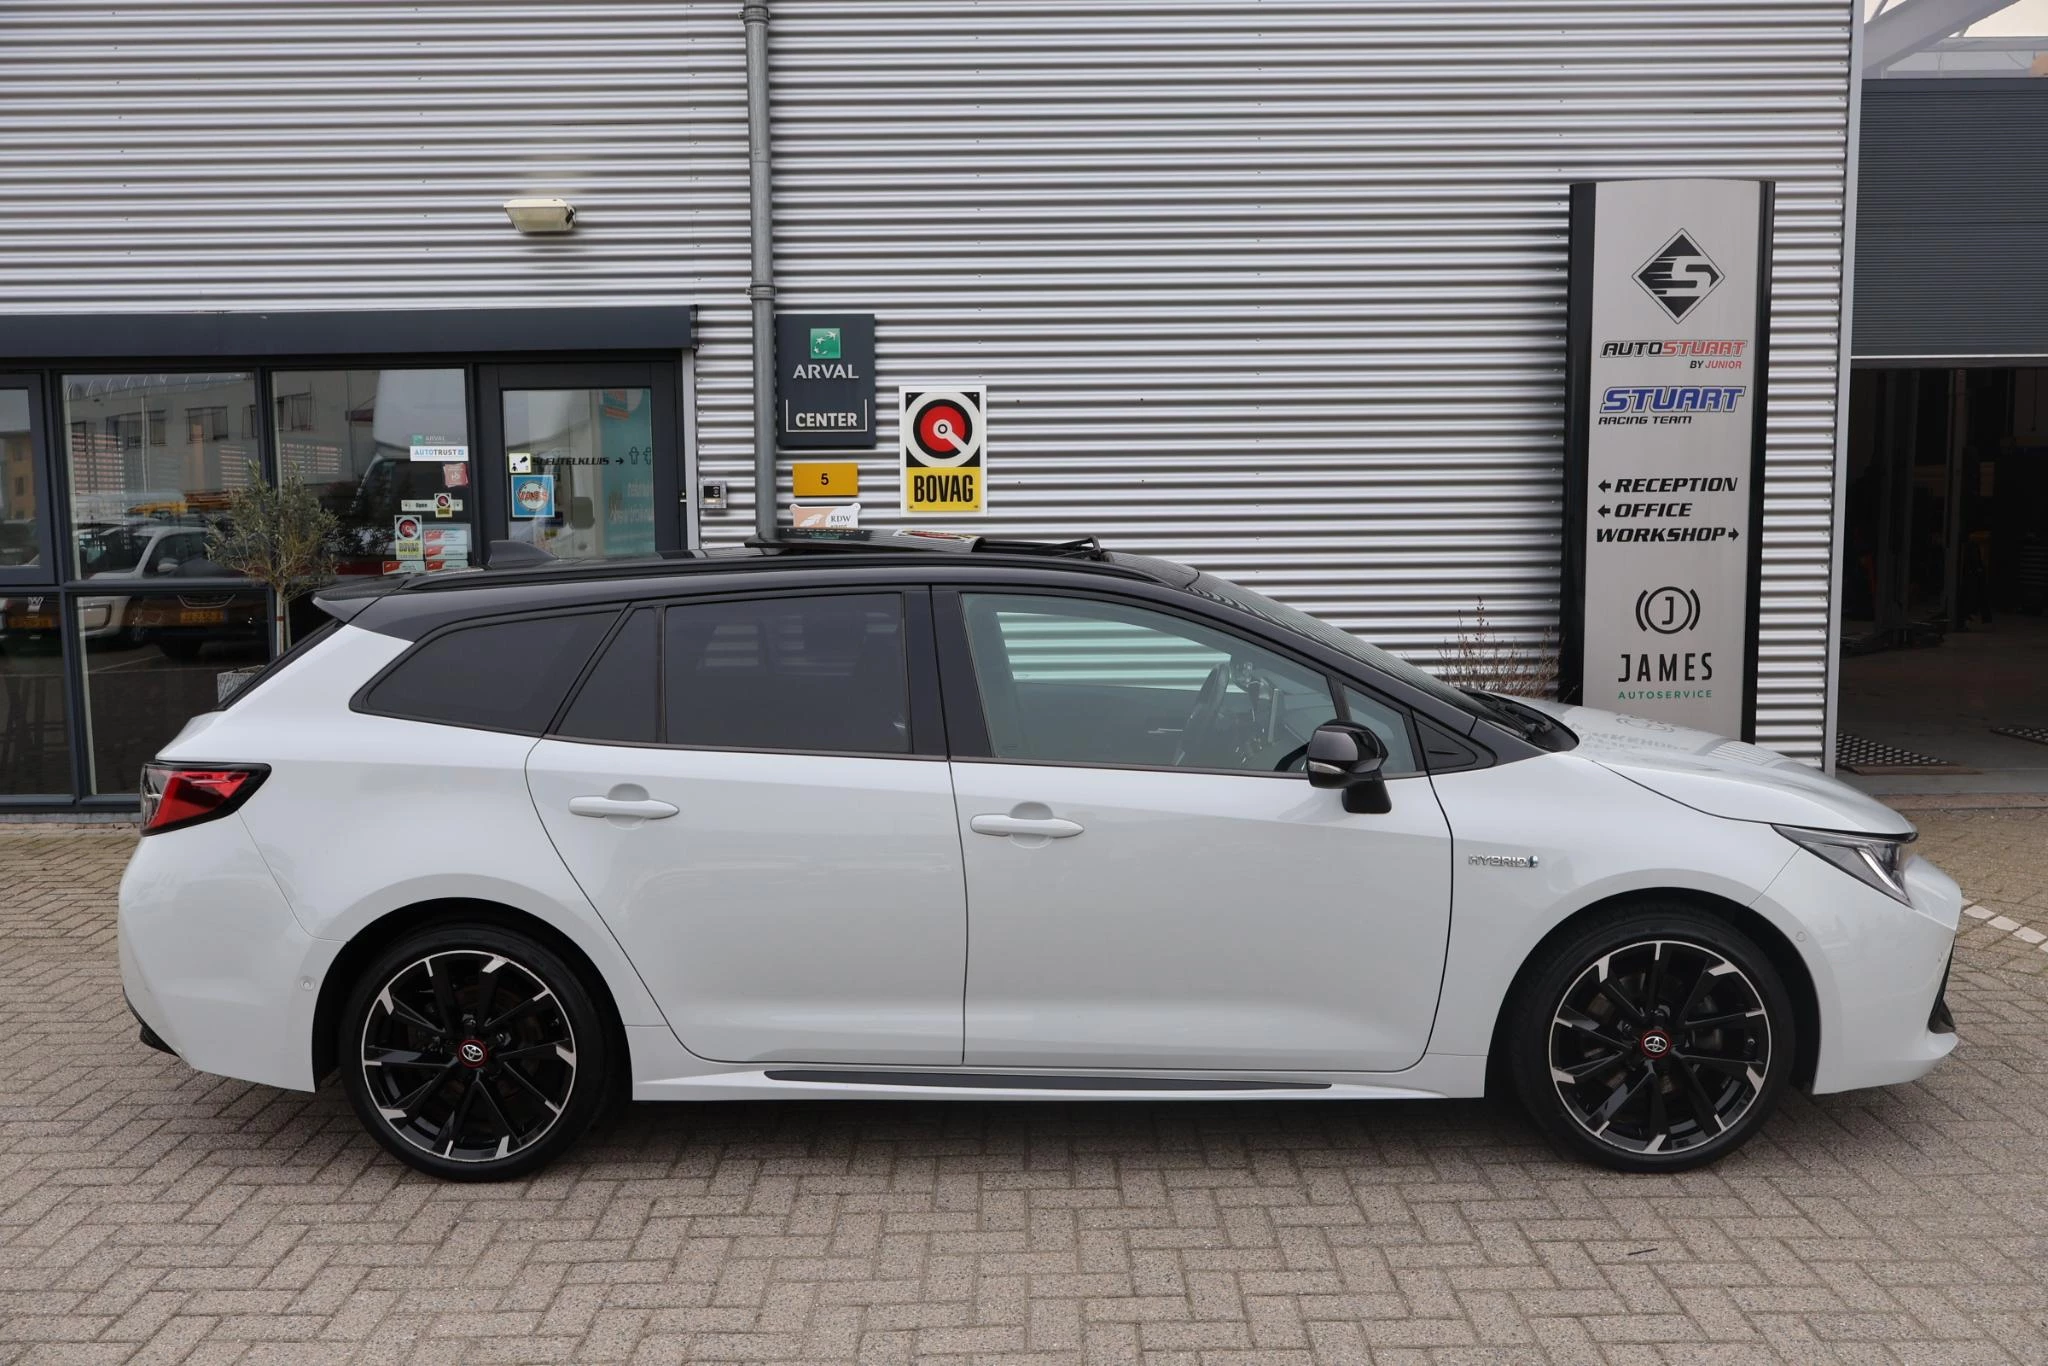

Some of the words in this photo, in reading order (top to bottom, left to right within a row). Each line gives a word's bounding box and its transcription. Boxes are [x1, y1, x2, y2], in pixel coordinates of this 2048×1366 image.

[1601, 340, 1747, 358] AUTOSTUART
[793, 364, 859, 379] ARVAL
[1690, 361, 1704, 369] BY
[1705, 360, 1742, 369] JUNIOR
[1600, 386, 1746, 413] STUART
[795, 412, 858, 427] CENTER
[1598, 416, 1648, 425] RACING
[1653, 416, 1692, 425] TEAM
[415, 448, 457, 456] AUTOTRUST
[820, 473, 829, 486] 5
[1614, 477, 1738, 493] RECEPTION
[913, 475, 974, 503] BOVAG
[1614, 503, 1693, 518] OFFICE
[830, 515, 851, 523] RDW
[1597, 527, 1726, 542] WORKSHOP
[1618, 652, 1713, 682] JAMES
[1618, 689, 1713, 700] AUTOSERVICE
[1468, 855, 1527, 867] HYBRID
